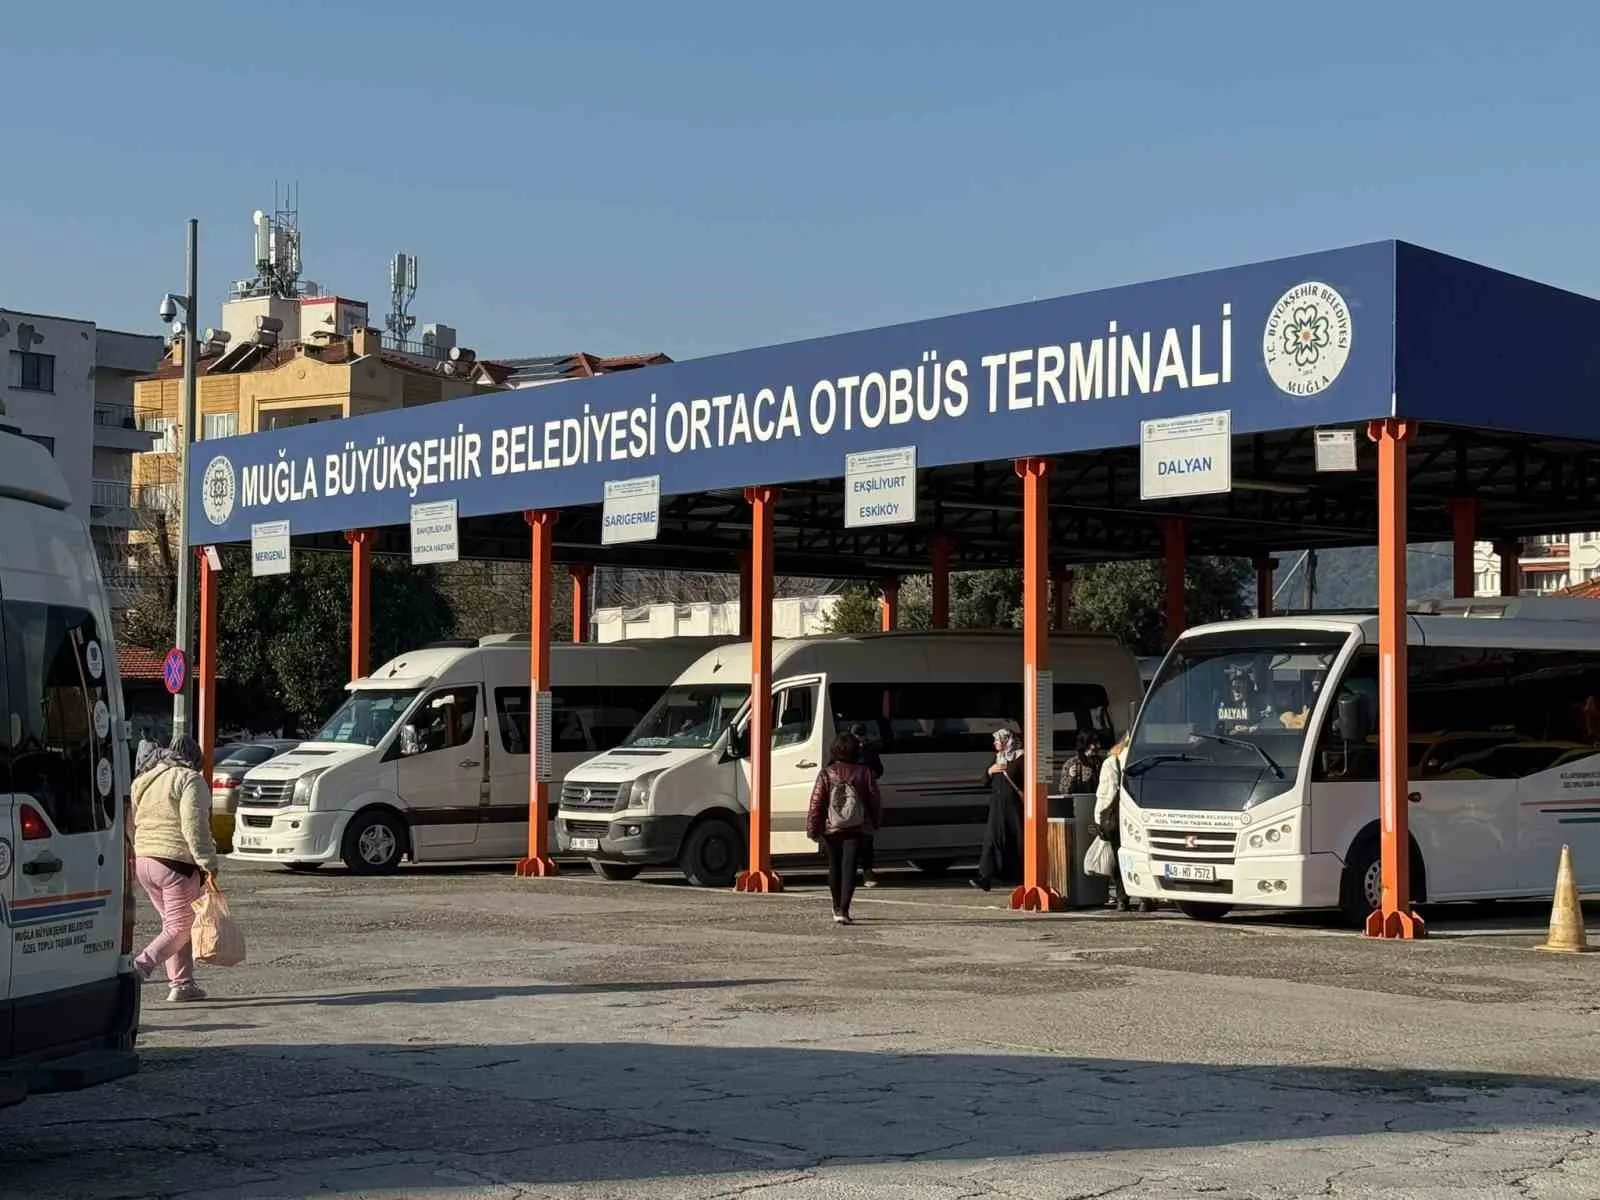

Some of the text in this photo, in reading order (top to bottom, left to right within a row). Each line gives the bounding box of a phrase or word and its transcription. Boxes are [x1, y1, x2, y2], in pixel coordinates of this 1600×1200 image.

[1287, 375, 1330, 394] MUĞLA
[241, 448, 318, 508] MUĞLA
[325, 423, 482, 498] BÜYÜKŞEHİR
[491, 393, 657, 476] BELEDİYESİ
[665, 385, 801, 453] ORTACA
[809, 349, 969, 435] OTOBÜS
[981, 302, 1232, 413] TERMİNALİ
[1158, 456, 1212, 476] DALYAN
[854, 476, 907, 494] EKŞİLİYURT
[605, 510, 657, 528] SARIGERME
[859, 502, 900, 518] ESKİKÖY
[1217, 707, 1248, 721] DALYAN
